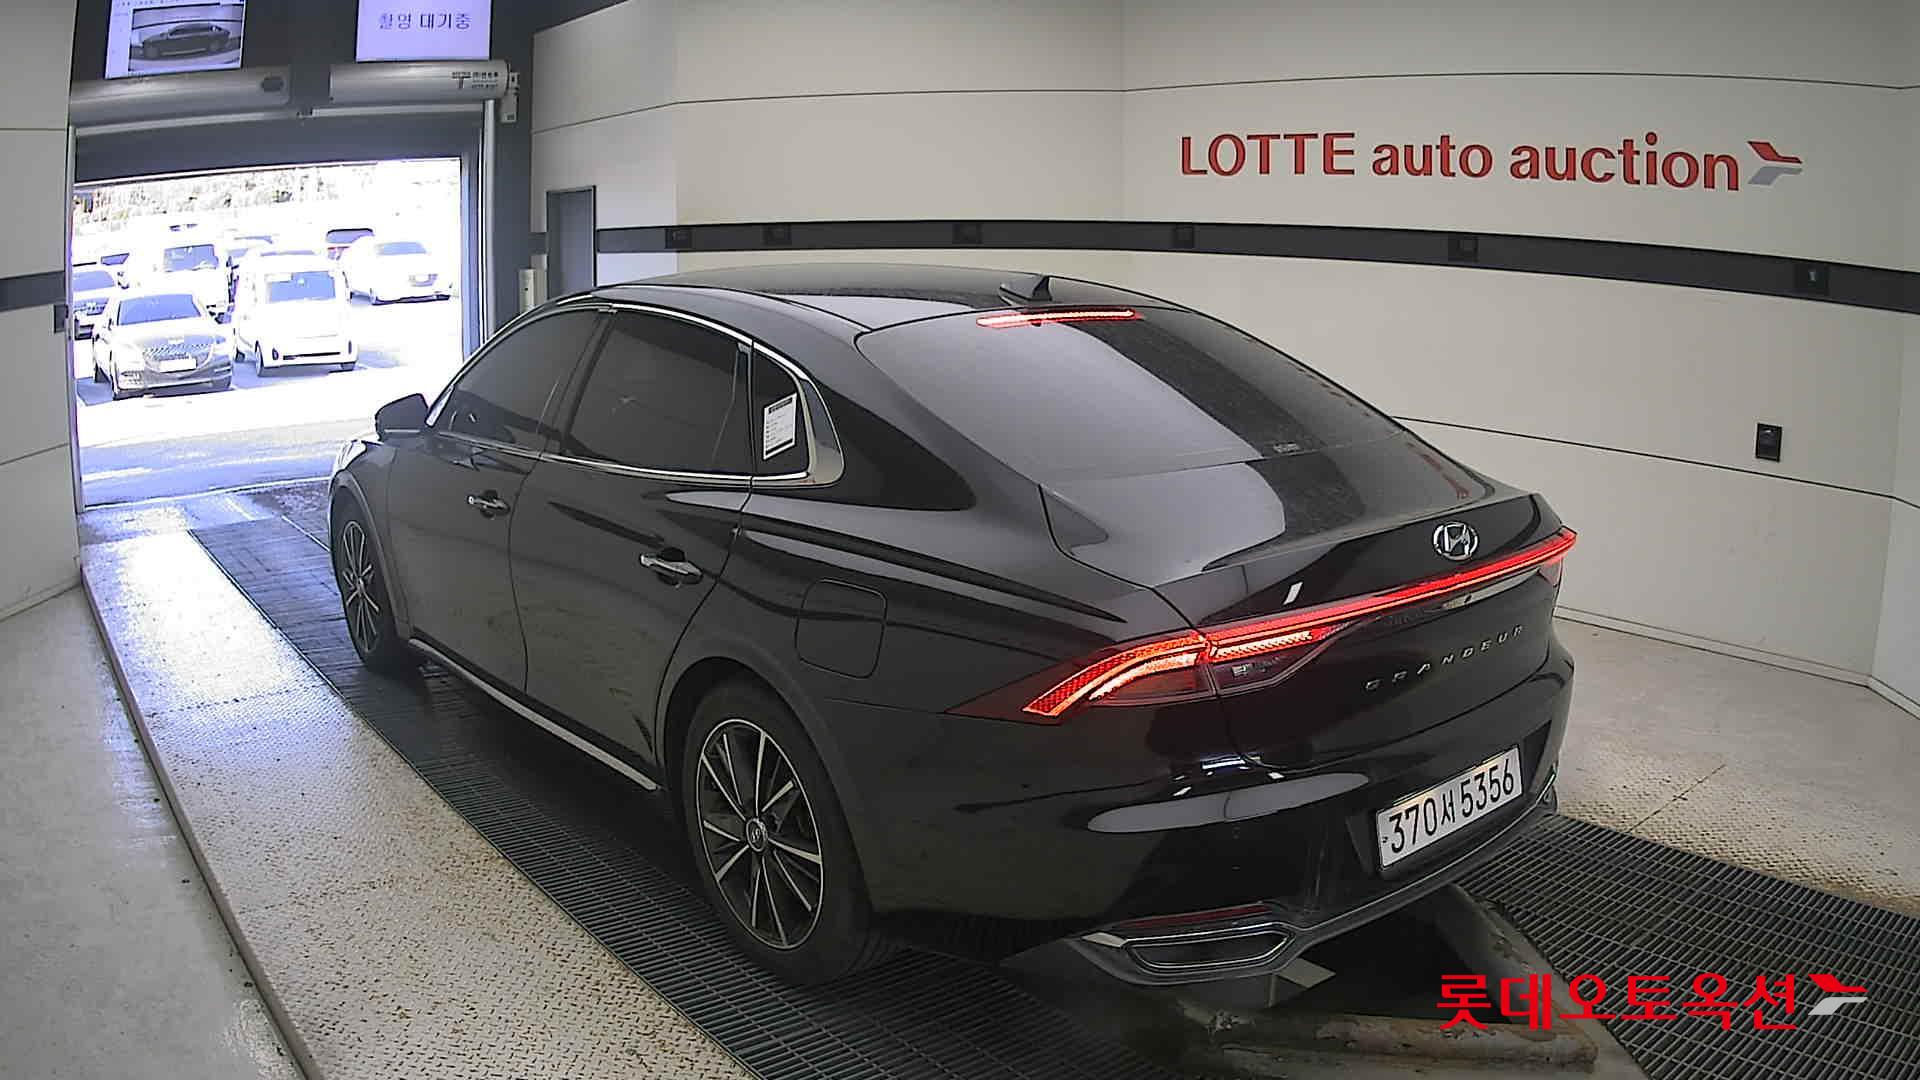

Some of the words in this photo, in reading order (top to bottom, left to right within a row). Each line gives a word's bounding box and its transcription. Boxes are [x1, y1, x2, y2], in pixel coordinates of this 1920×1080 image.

[419, 13, 472, 30] 대기중
[1181, 132, 1355, 176] LOTTE
[1371, 134, 1494, 178] auto
[1509, 131, 1739, 191] auction
[1364, 624, 1523, 691] GRANDEUR
